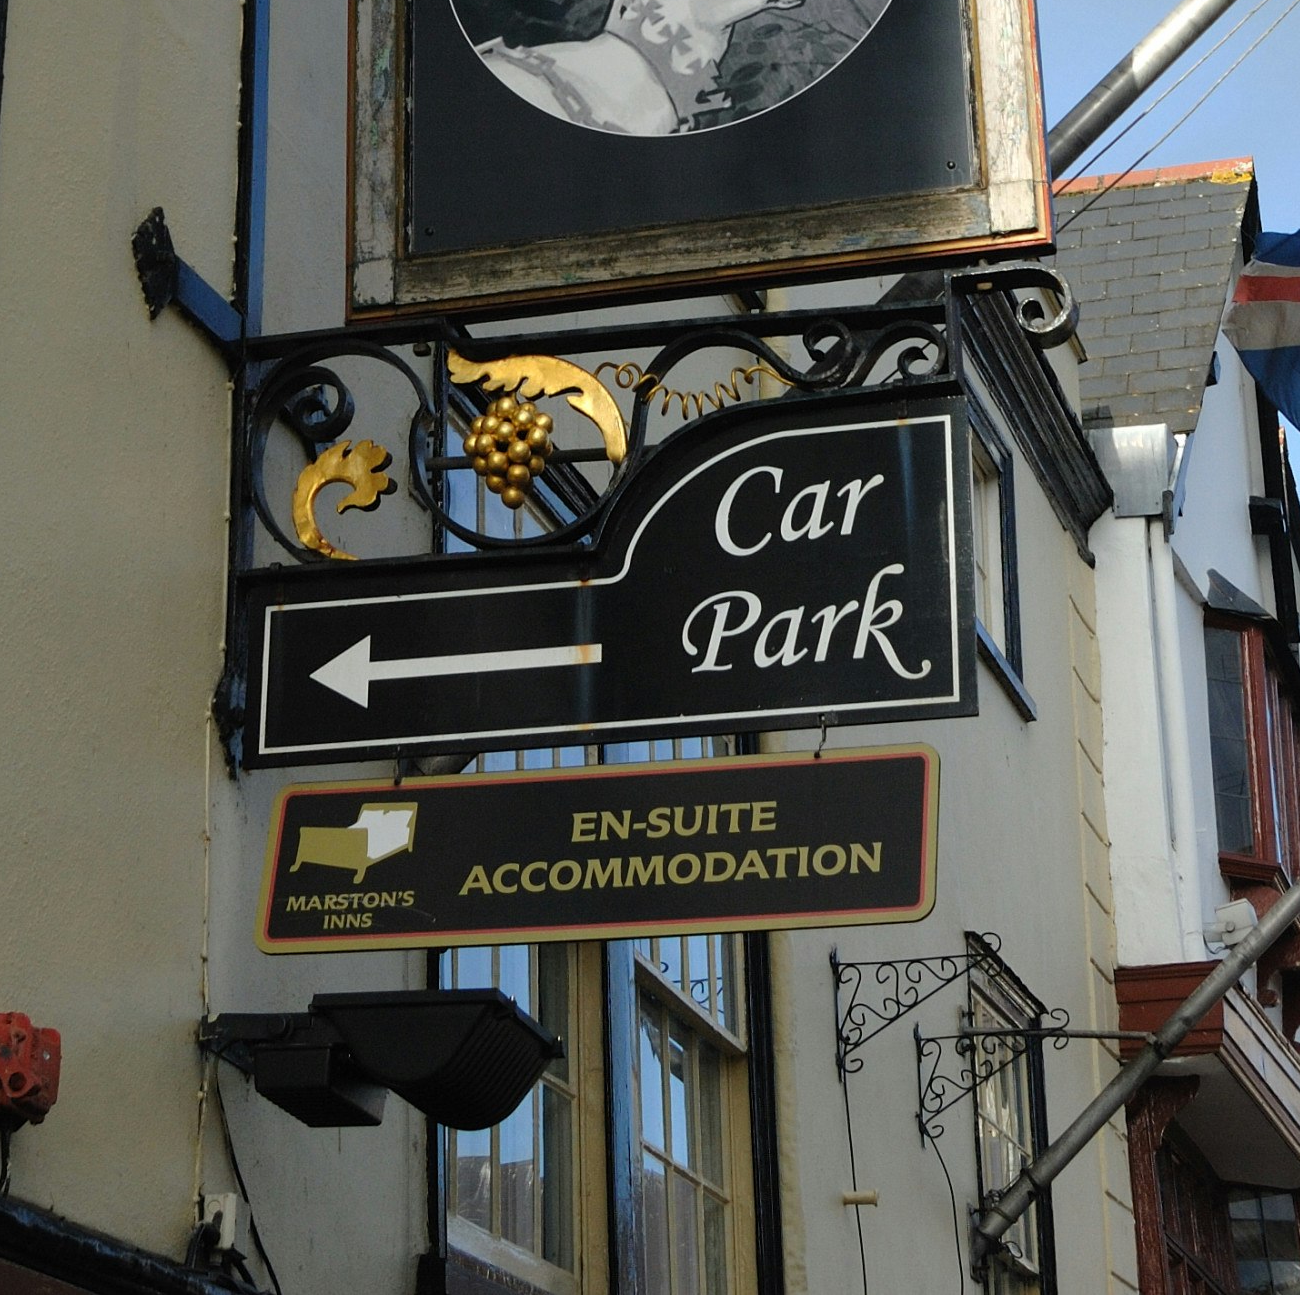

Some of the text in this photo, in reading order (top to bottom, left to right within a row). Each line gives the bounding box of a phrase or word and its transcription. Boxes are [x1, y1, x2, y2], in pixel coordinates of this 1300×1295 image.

[714, 465, 885, 557] Car
[681, 563, 932, 680] Park
[571, 800, 777, 843] EN-SUITE
[458, 841, 883, 896] ACCOMMODATION
[285, 889, 415, 912] MARSTON'S
[322, 912, 373, 929] INNS
